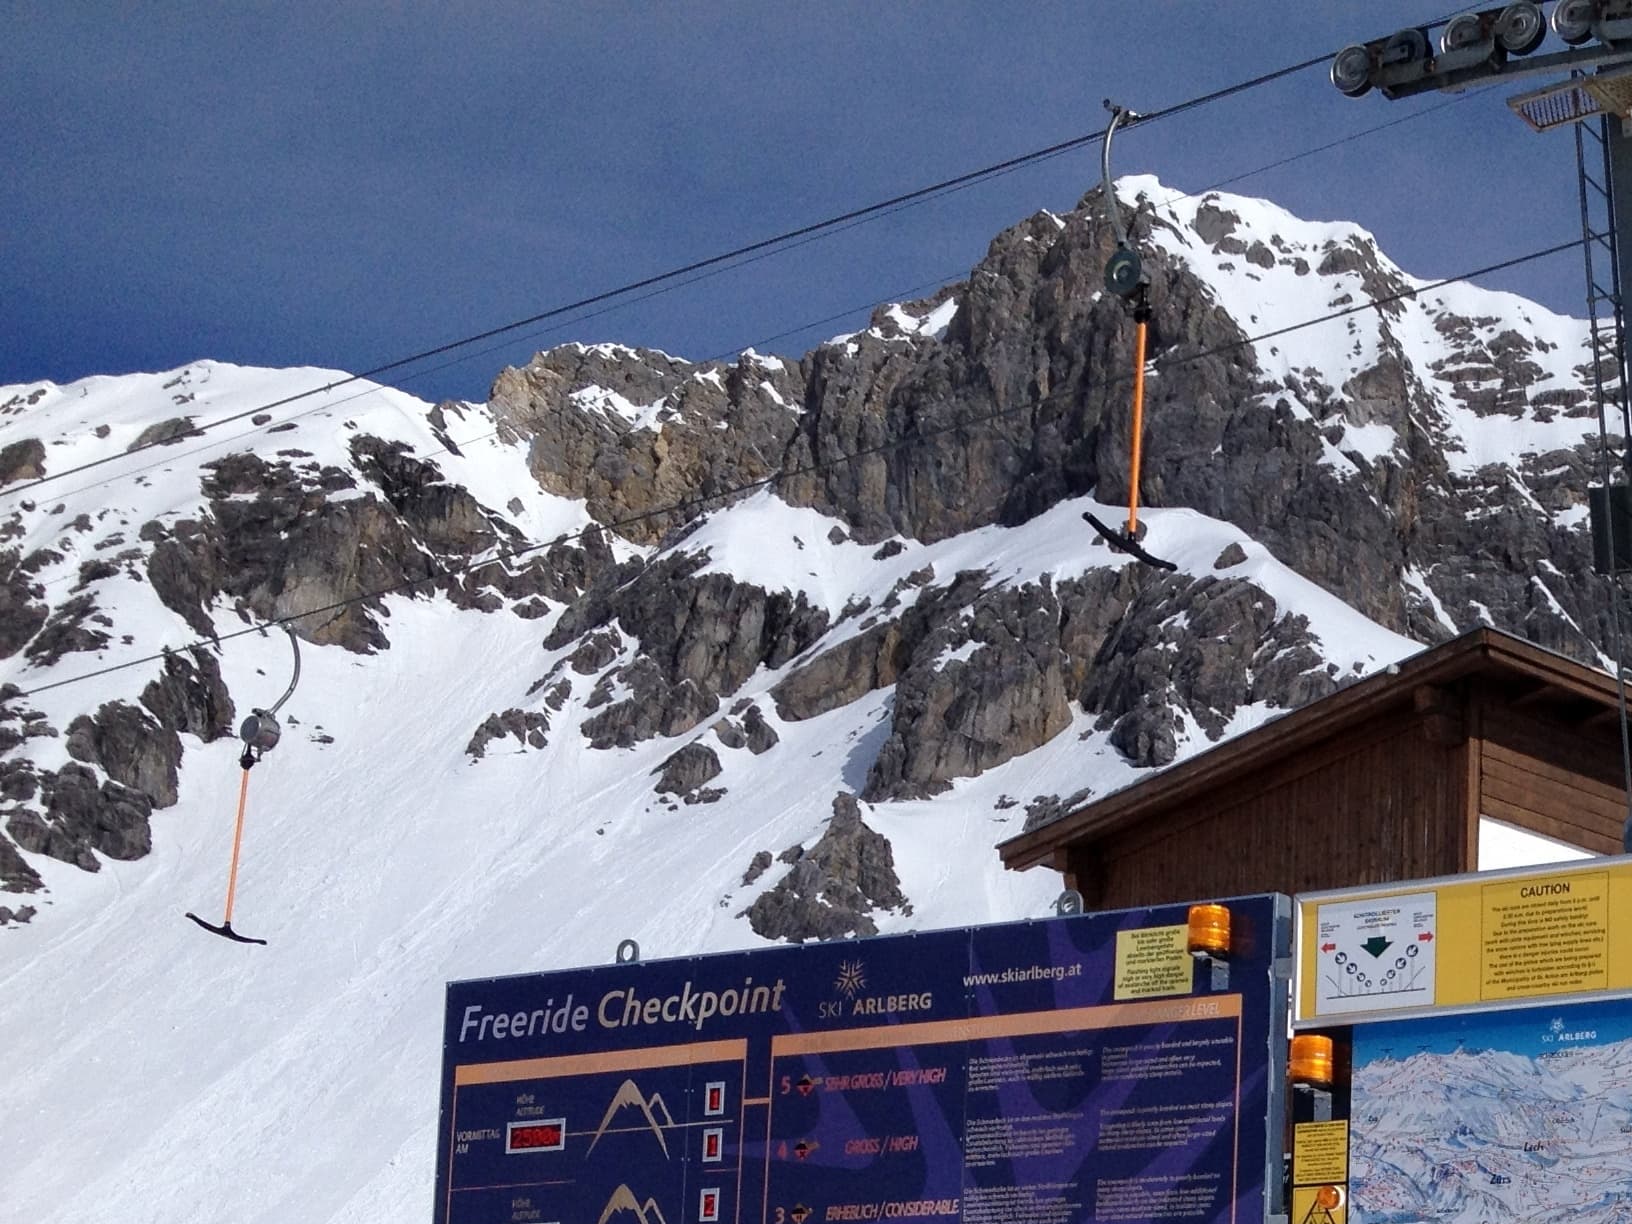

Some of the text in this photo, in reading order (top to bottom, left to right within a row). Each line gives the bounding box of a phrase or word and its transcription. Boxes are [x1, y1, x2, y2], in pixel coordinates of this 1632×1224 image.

[1520, 882, 1570, 898] CAUTION
[963, 963, 1081, 988] www.skiarlberg.at
[458, 994, 589, 1042] Freeride
[598, 978, 786, 1031] Checkpoint
[818, 992, 932, 1018] SKI ARLBERG
[781, 1076, 791, 1094] 5
